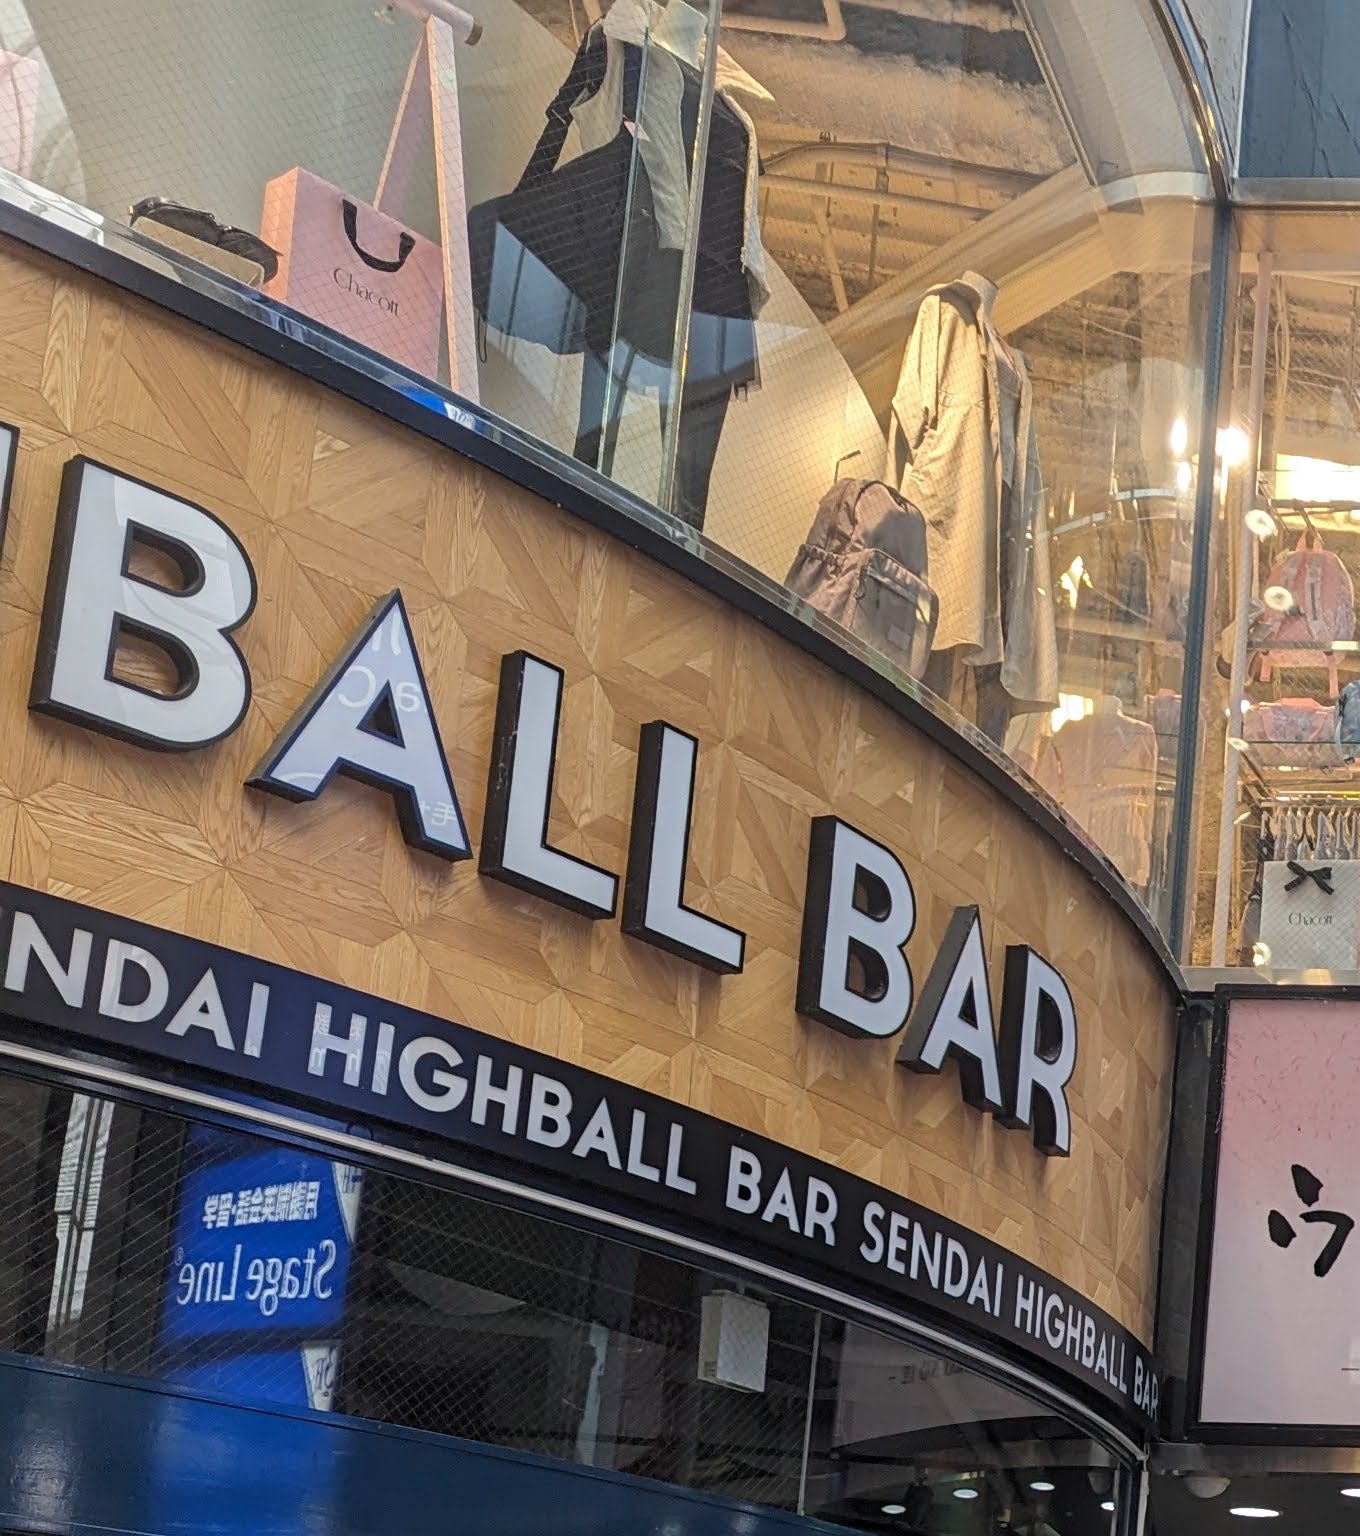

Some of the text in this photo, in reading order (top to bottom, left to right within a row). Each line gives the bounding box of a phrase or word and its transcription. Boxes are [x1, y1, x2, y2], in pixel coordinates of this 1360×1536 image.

[333, 267, 400, 319] Chacott
[0, 424, 1078, 1157] BALL BAR
[1288, 910, 1333, 926] Chacott
[307, 1002, 698, 1197] HIGHBALL
[726, 1144, 838, 1246] BAR
[859, 1200, 1005, 1318] SENDAI
[1014, 1274, 1134, 1396] HIGHBALL
[1134, 1355, 1160, 1422] BAR
